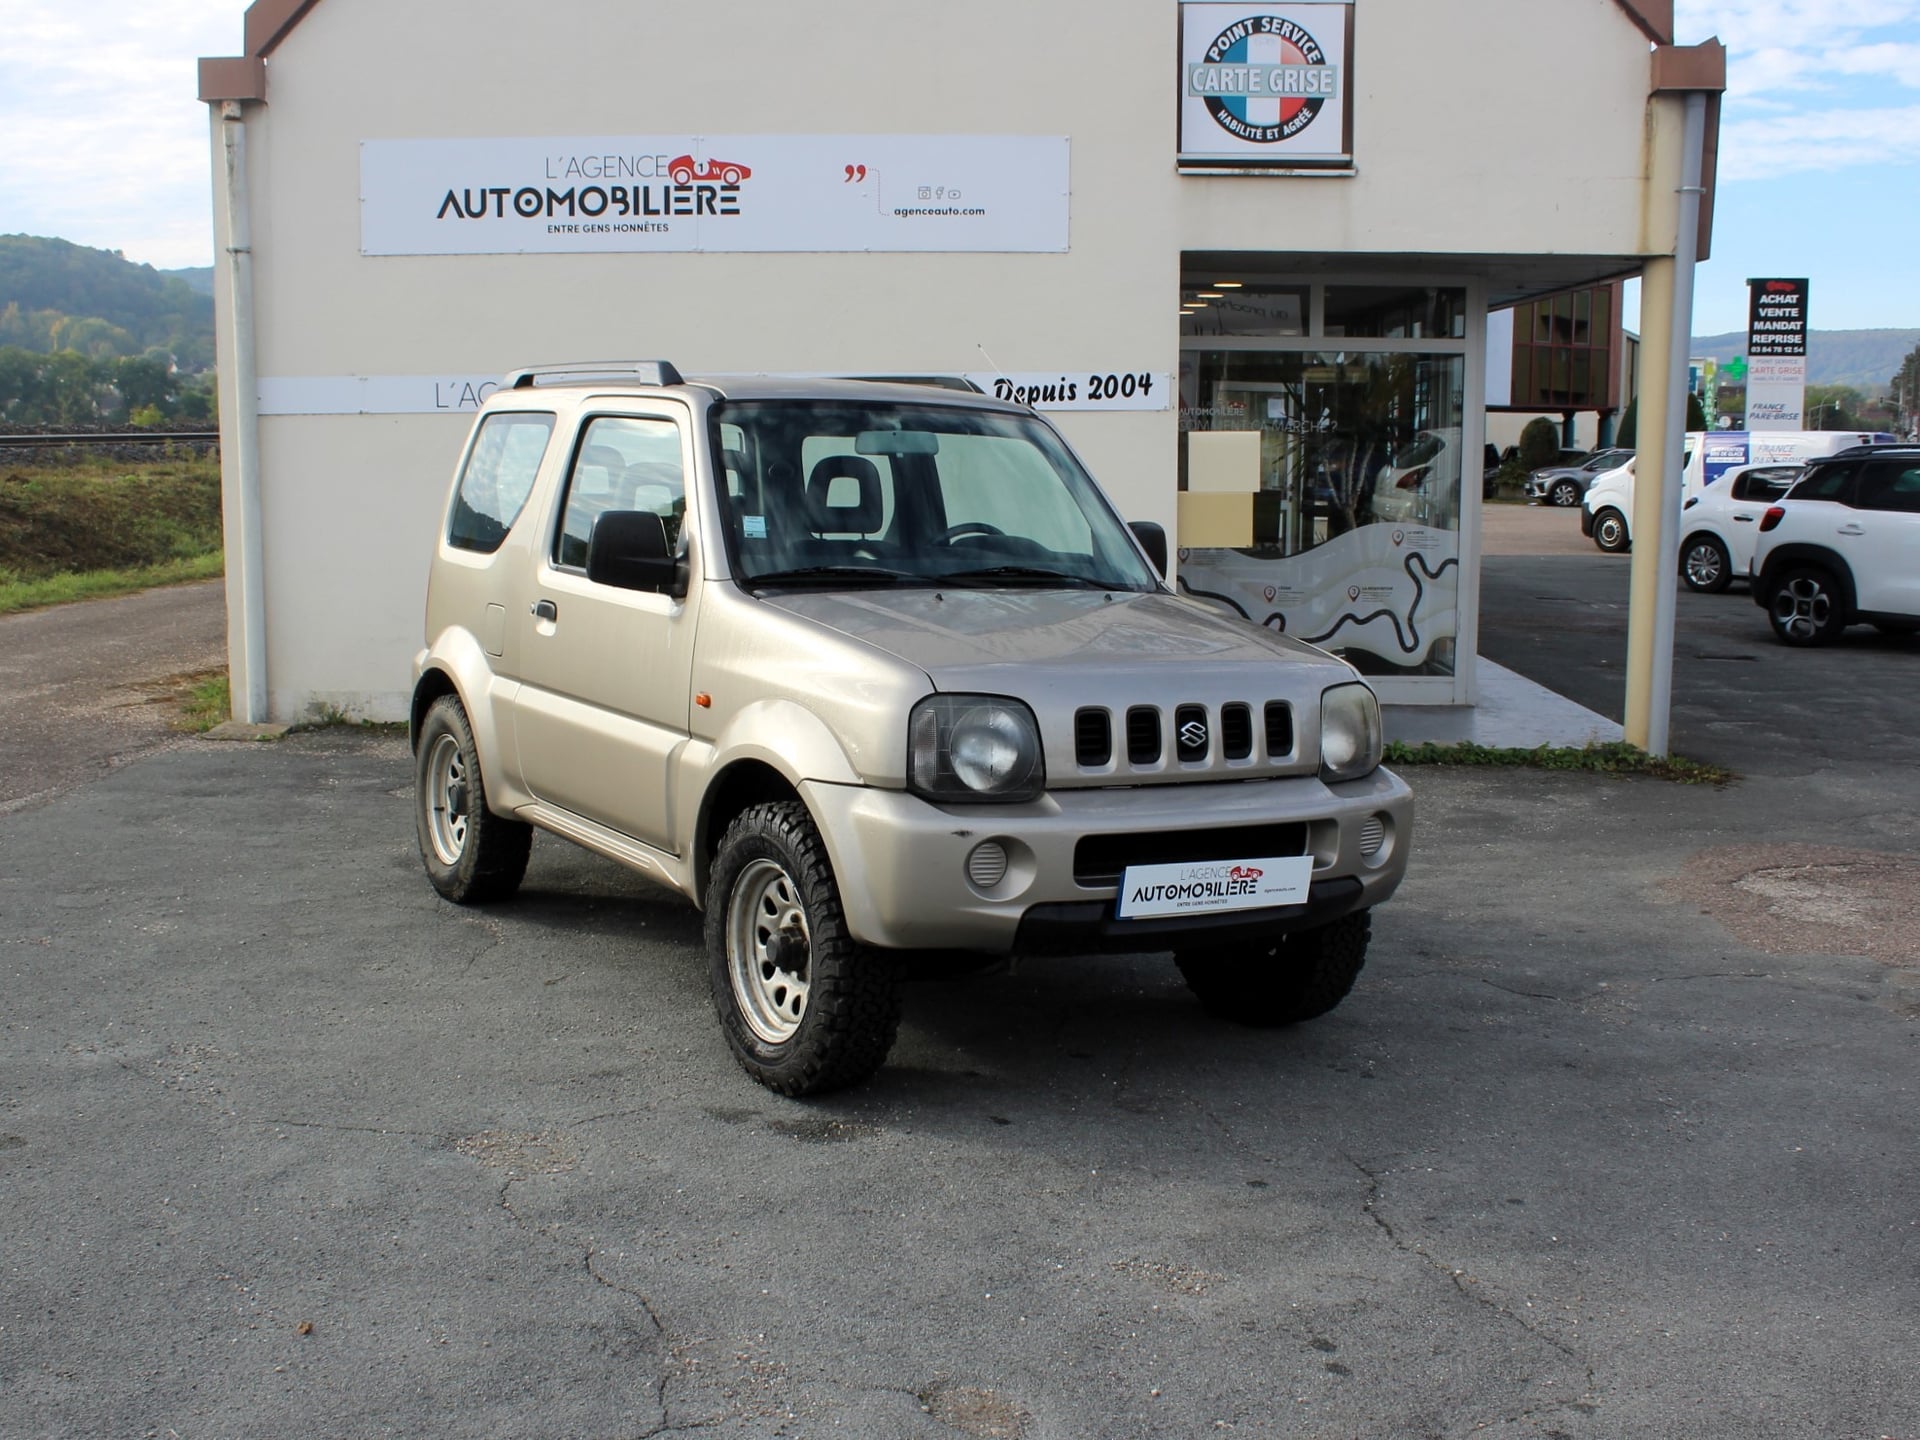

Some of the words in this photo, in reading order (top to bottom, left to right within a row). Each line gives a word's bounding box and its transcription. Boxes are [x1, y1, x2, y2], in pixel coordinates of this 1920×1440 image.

[1208, 19, 1255, 61] POINT
[1261, 17, 1321, 64] SERVICE
[1191, 68, 1261, 93] CARTE
[1268, 69, 1333, 94] GRISE
[1217, 109, 1263, 140] HABILITÉ
[1266, 128, 1279, 139] ET
[1283, 107, 1313, 136] AGRÉÉ
[545, 155, 669, 180] L'AGENCE
[894, 206, 985, 218] agenceauto.com
[547, 224, 580, 234] ENTRE
[583, 223, 611, 233] GENS
[613, 220, 669, 233] HONNÊTES
[1759, 294, 1799, 304] ACHAT
[1758, 307, 1799, 317] VENTE
[1753, 321, 1803, 331] MANDAT
[1752, 334, 1802, 344] REPRISE
[1750, 366, 1775, 375] CARTE
[1778, 366, 1803, 375] GRISE
[994, 376, 1077, 403] Depuis
[1087, 372, 1153, 400] 2004
[1749, 412, 1799, 421] PARE-BRISE
[1758, 444, 1798, 453] FRANCE
[1180, 866, 1231, 881] L'AGENCE
